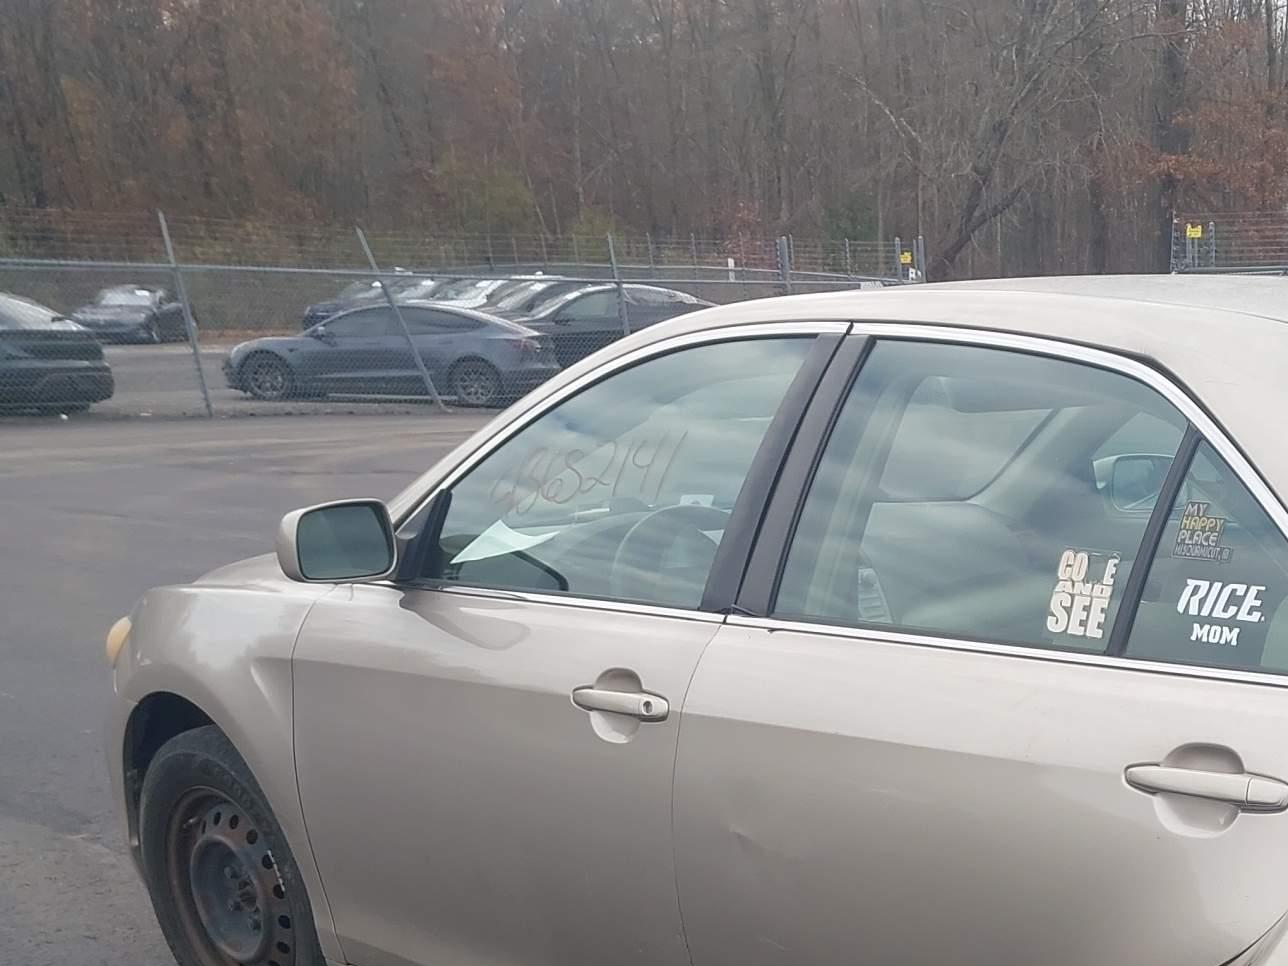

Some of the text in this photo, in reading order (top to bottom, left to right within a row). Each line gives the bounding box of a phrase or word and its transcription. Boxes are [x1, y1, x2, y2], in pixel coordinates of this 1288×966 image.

[1184, 503, 1208, 516] MY
[1181, 516, 1225, 531] HAPPY
[1177, 530, 1218, 546] PLACE
[1058, 549, 1120, 585] COE
[1055, 580, 1113, 599] AND
[1047, 592, 1110, 638] SEE
[1190, 623, 1240, 646] MOM
